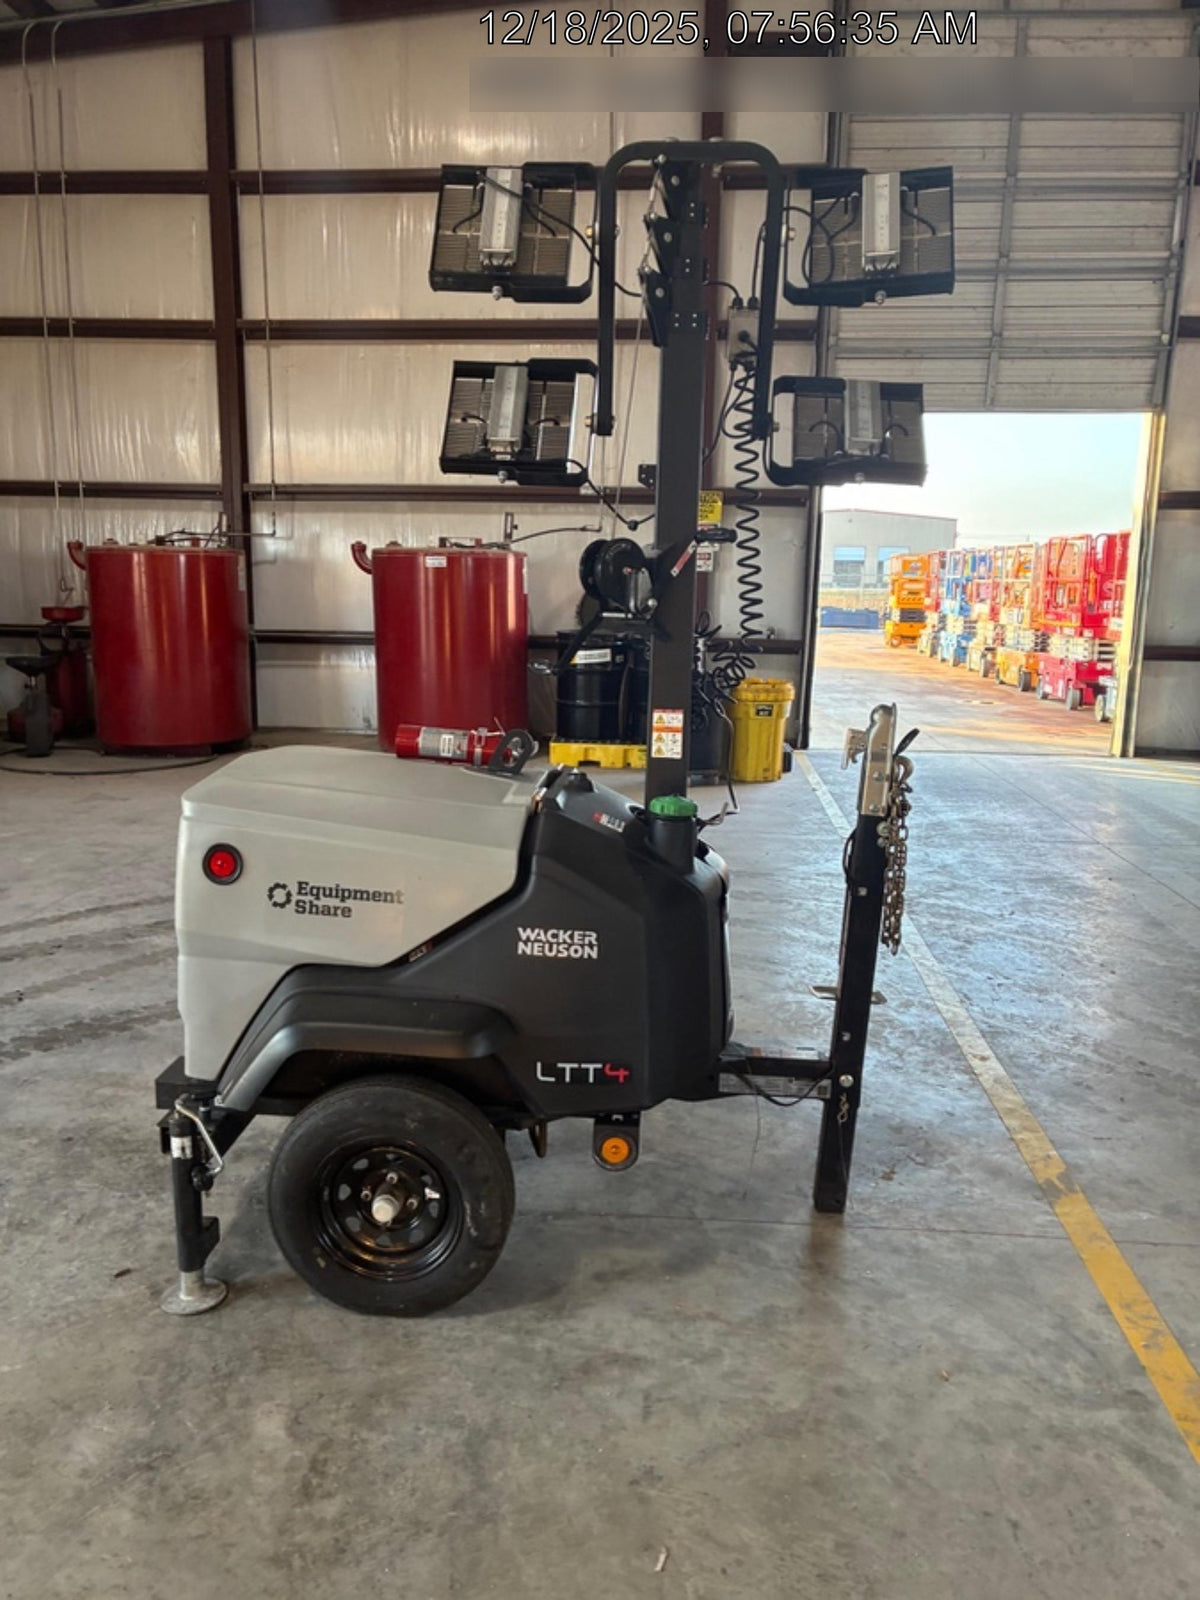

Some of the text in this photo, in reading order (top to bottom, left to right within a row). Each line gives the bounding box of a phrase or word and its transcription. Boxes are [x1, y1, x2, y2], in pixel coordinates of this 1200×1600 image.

[296, 881, 404, 904] Equipment
[294, 899, 352, 918] Share
[517, 927, 598, 945] WACKER
[517, 941, 598, 959] NEUSON
[536, 1061, 630, 1084] LTT4
